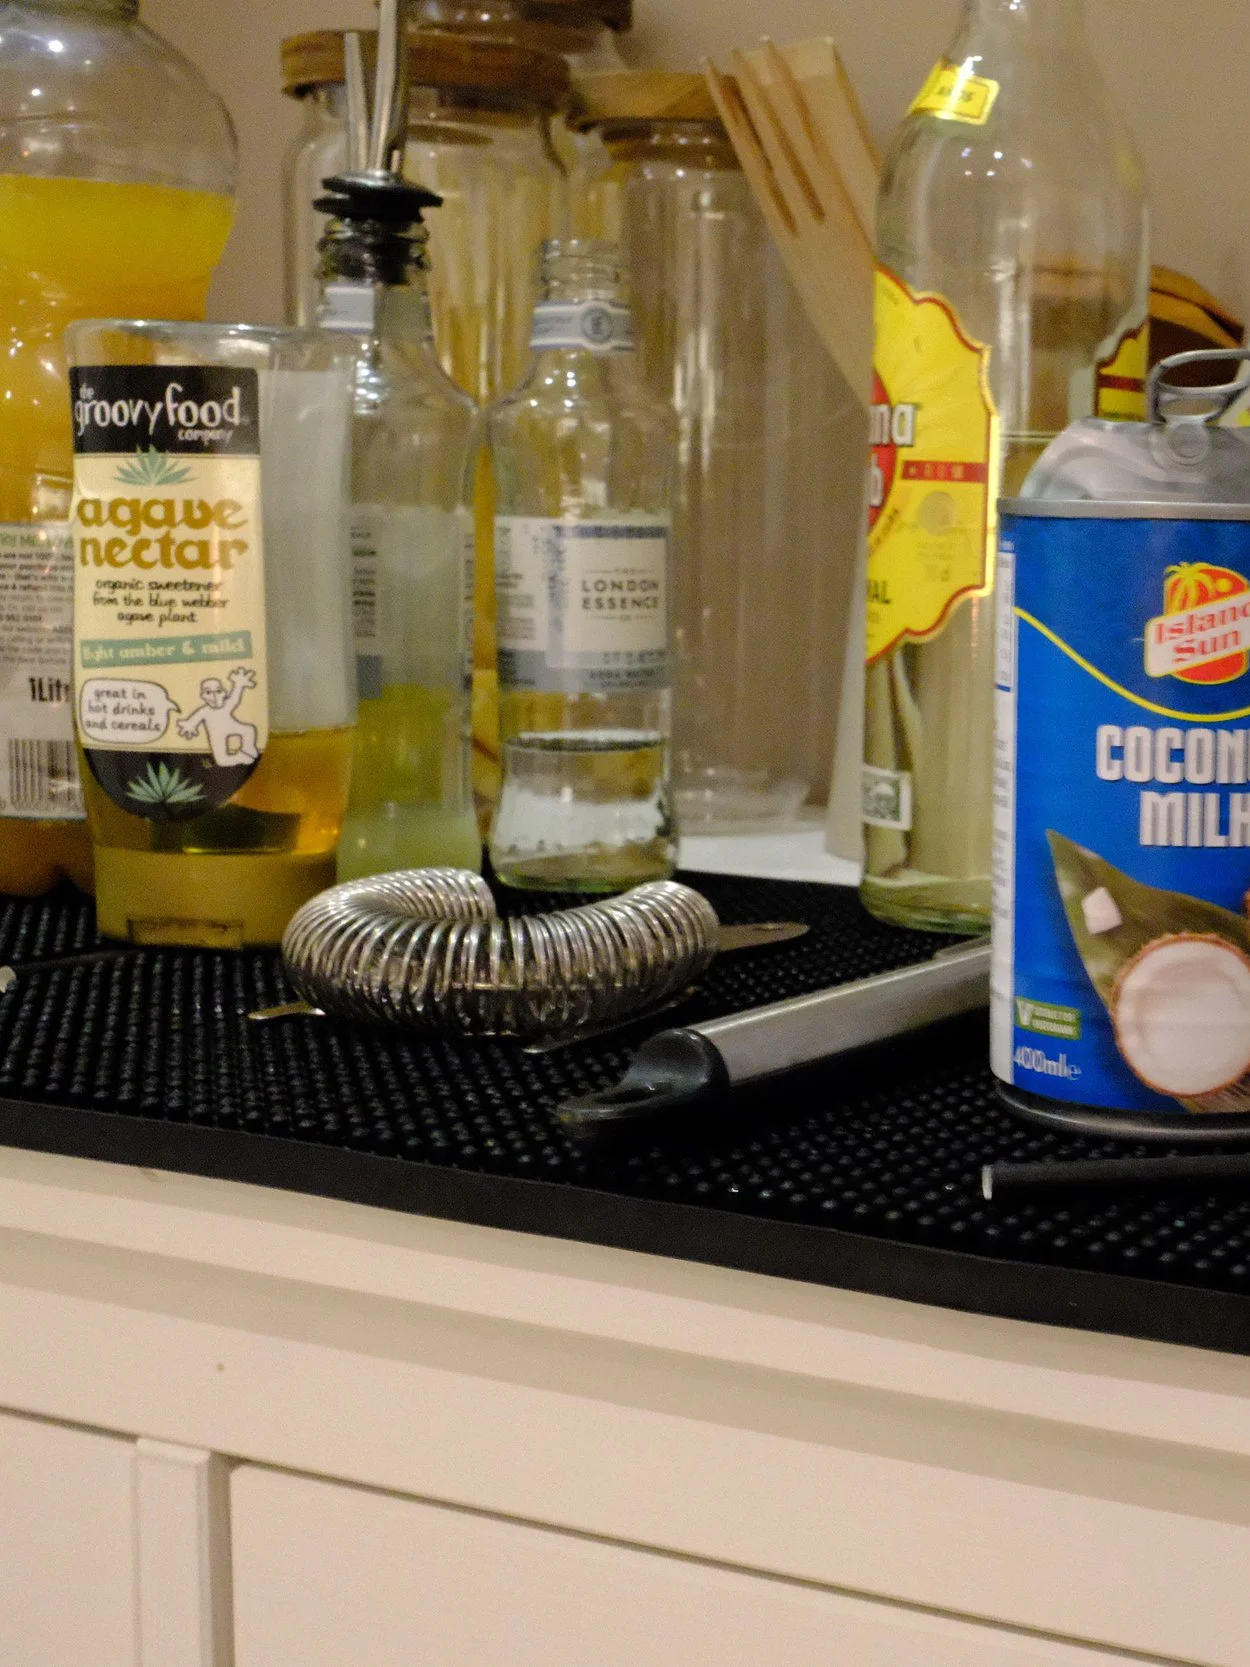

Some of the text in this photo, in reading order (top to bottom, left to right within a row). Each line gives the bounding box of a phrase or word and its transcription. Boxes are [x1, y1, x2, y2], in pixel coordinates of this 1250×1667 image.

[77, 498, 249, 537] agave
[79, 529, 249, 570] nectar
[95, 578, 225, 595] organic sweetener
[581, 578, 660, 593] LONDON
[92, 592, 118, 607] from
[123, 594, 144, 607] the
[149, 593, 178, 608] blue
[580, 597, 659, 611] ESSENCE
[117, 608, 199, 628] agave plant
[118, 643, 175, 658] amber
[181, 640, 195, 655] &
[201, 636, 246, 654] mild
[1172, 629, 1241, 666] Sun
[94, 688, 147, 700] great in
[88, 701, 156, 716] hot drinks
[85, 717, 162, 732] and cereals
